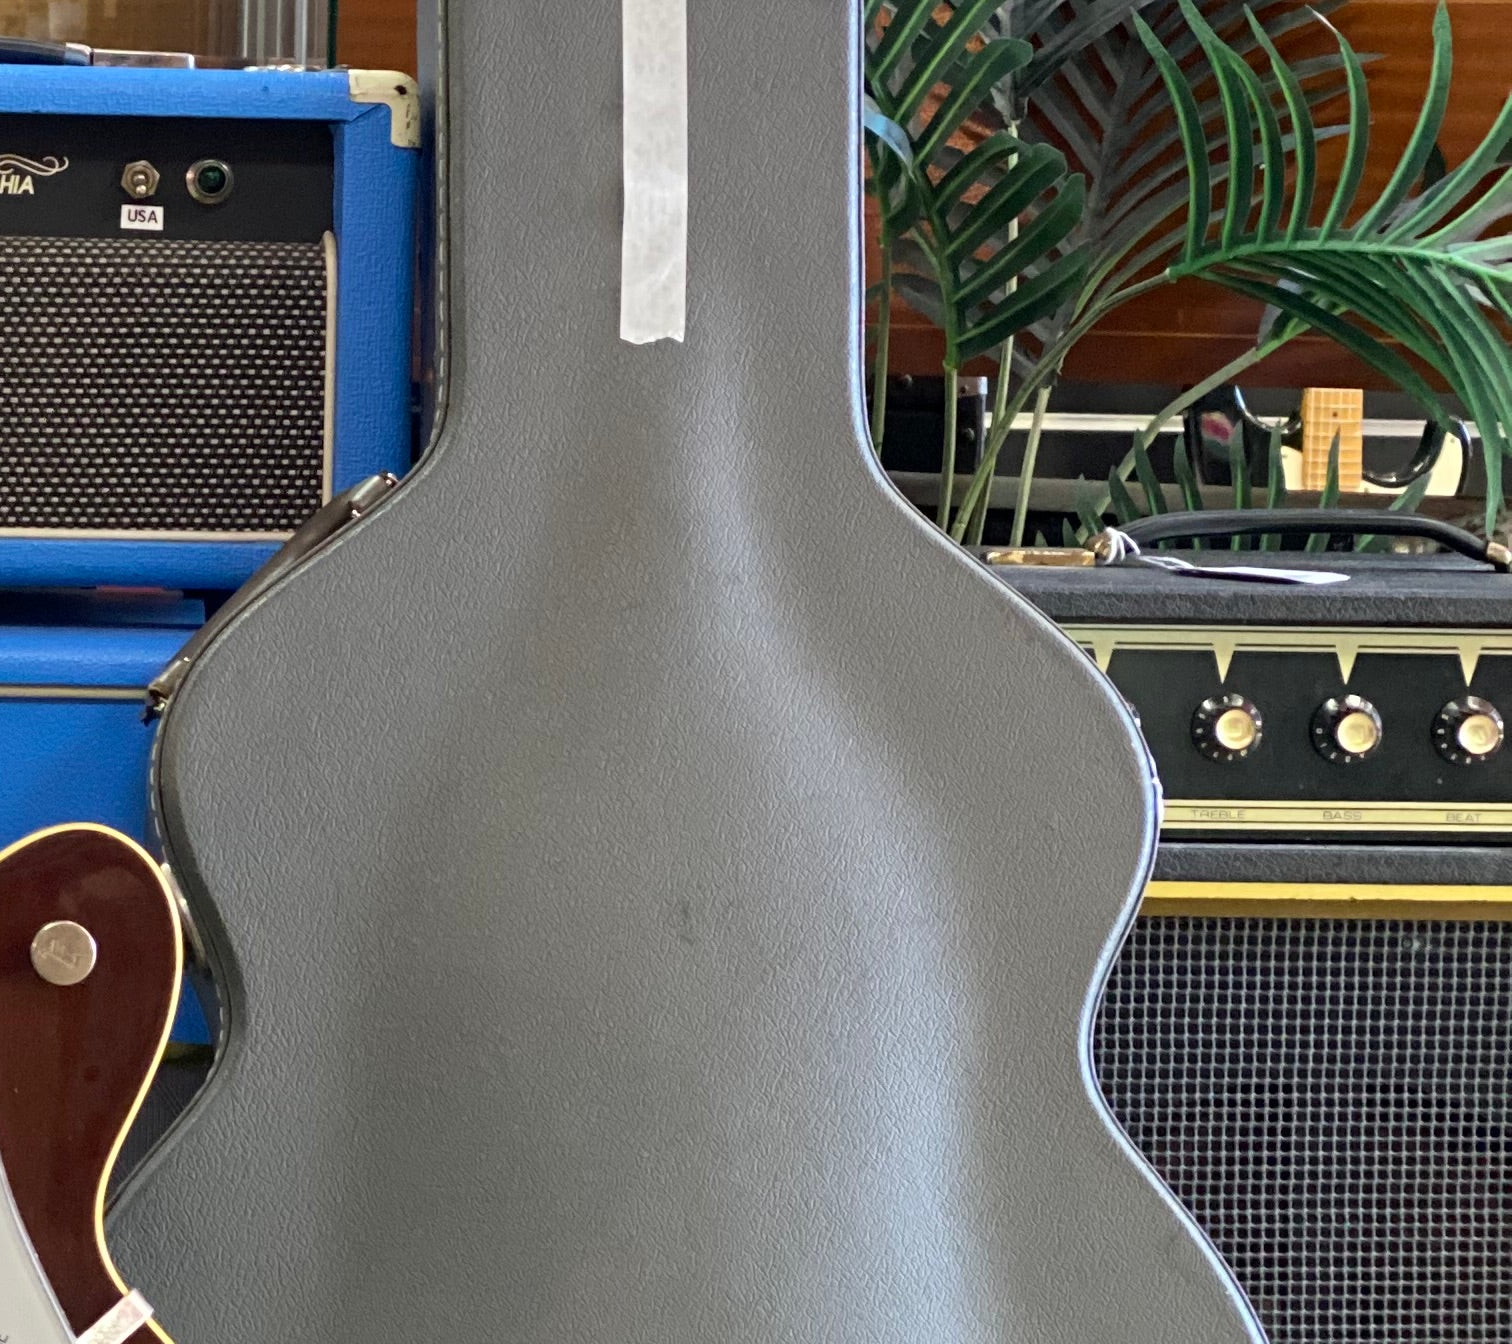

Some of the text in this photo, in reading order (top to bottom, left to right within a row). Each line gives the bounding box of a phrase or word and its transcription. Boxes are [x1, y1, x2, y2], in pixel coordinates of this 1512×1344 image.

[127, 209, 158, 224] USA
[1191, 810, 1483, 823] TREBLE BASS BEAT
